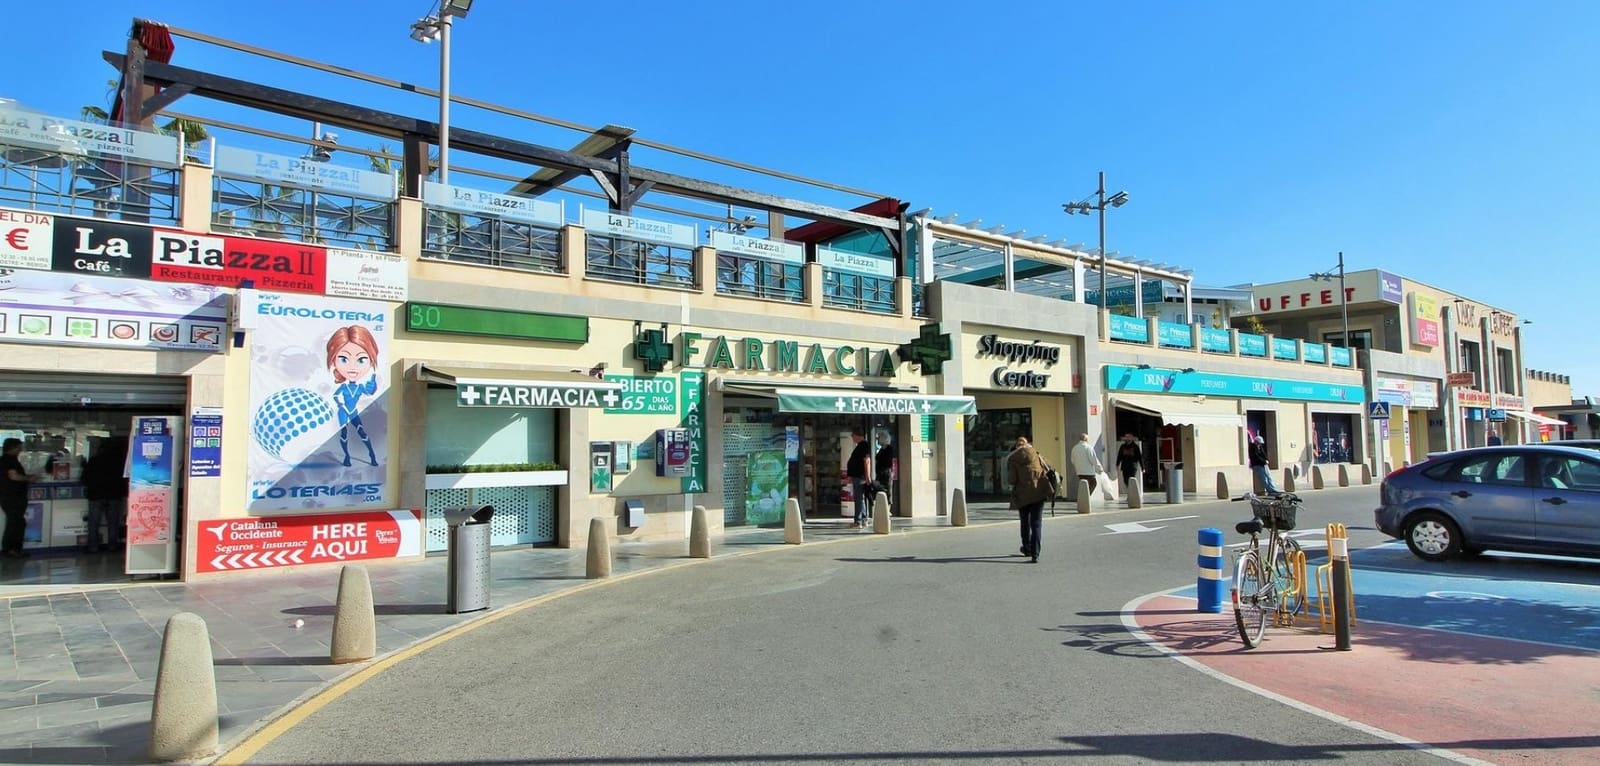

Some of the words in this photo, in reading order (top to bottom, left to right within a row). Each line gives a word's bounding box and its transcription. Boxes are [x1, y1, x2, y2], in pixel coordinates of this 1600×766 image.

[0, 116, 30, 129] La
[41, 117, 121, 144] Piazza
[97, 143, 135, 154] pizzeria
[256, 154, 279, 169] La
[288, 158, 349, 182] Piazza
[454, 187, 473, 201] La
[479, 191, 526, 210] Piazza
[24, 213, 50, 226] DIA
[608, 215, 622, 227] La
[627, 218, 666, 234] Piazza
[74, 226, 132, 258] La
[159, 237, 294, 273] Piazza
[297, 250, 314, 276] II
[732, 235, 745, 247] La
[748, 239, 780, 253] Piazza
[73, 258, 111, 272] Café
[834, 253, 845, 263] La
[847, 255, 874, 268] Piazza
[262, 275, 314, 290] Pizzeria
[257, 302, 385, 323] EUROLOTERIA
[410, 305, 441, 328] 30
[682, 332, 897, 378] FARMACIA
[977, 334, 1061, 365] Shopping
[992, 366, 1052, 388] Center
[485, 386, 599, 406] FARMACIA
[612, 395, 645, 411] 65
[658, 403, 673, 411] AÑO
[851, 398, 917, 413] FARMACIA
[687, 389, 701, 491] FARMACIA
[252, 482, 385, 500] LOTERIASS
[230, 520, 278, 532] Catalana
[230, 529, 284, 540] Occidente
[312, 522, 368, 540] HERE
[215, 543, 254, 554] Seguros
[262, 540, 309, 550] Insurance
[310, 539, 368, 560] AQUI
